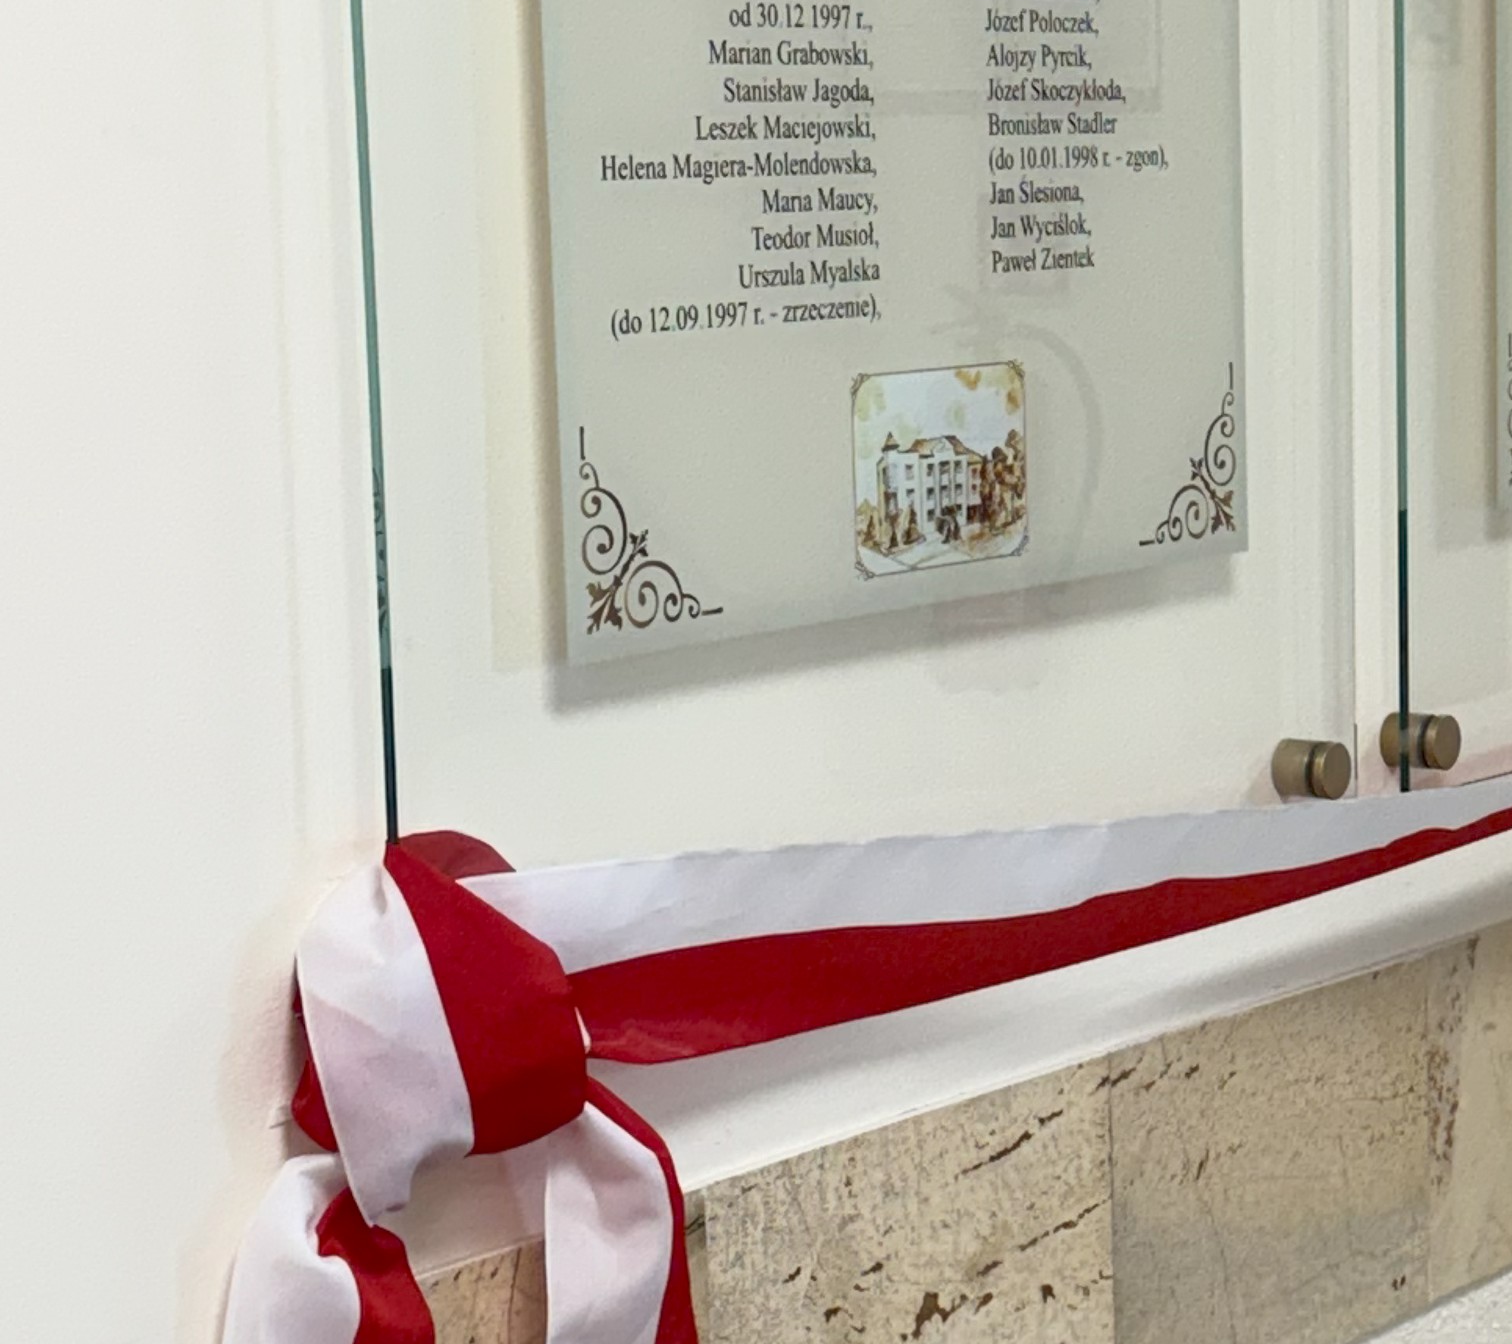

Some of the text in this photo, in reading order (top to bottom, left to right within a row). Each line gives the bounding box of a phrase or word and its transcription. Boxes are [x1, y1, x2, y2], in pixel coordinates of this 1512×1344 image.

[728, 1, 752, 28] od
[984, 8, 1099, 35] Józef Poloczek,
[708, 39, 874, 69] Marian Grabowski,
[985, 42, 1036, 73] Alojzy
[722, 76, 875, 109] Stanisław Jagoda,
[986, 77, 1028, 102] Józef
[695, 112, 876, 145] Leszek Maciejowski,
[987, 111, 1118, 136] Bronisław Stadler
[600, 149, 877, 186] Helena Magiera-Molendowska,
[988, 146, 1015, 175] (do
[1020, 145, 1099, 170] 10.01.1998
[1125, 144, 1169, 172] zgon),
[988, 181, 1015, 205] Jan
[750, 221, 880, 251] Teodor Musioł,
[990, 215, 1016, 240] Jan
[738, 256, 880, 289] Urszula Myalska
[991, 244, 1095, 273] Paweł Zientek
[610, 308, 643, 342] (do
[649, 300, 748, 333] 12.09.1997
